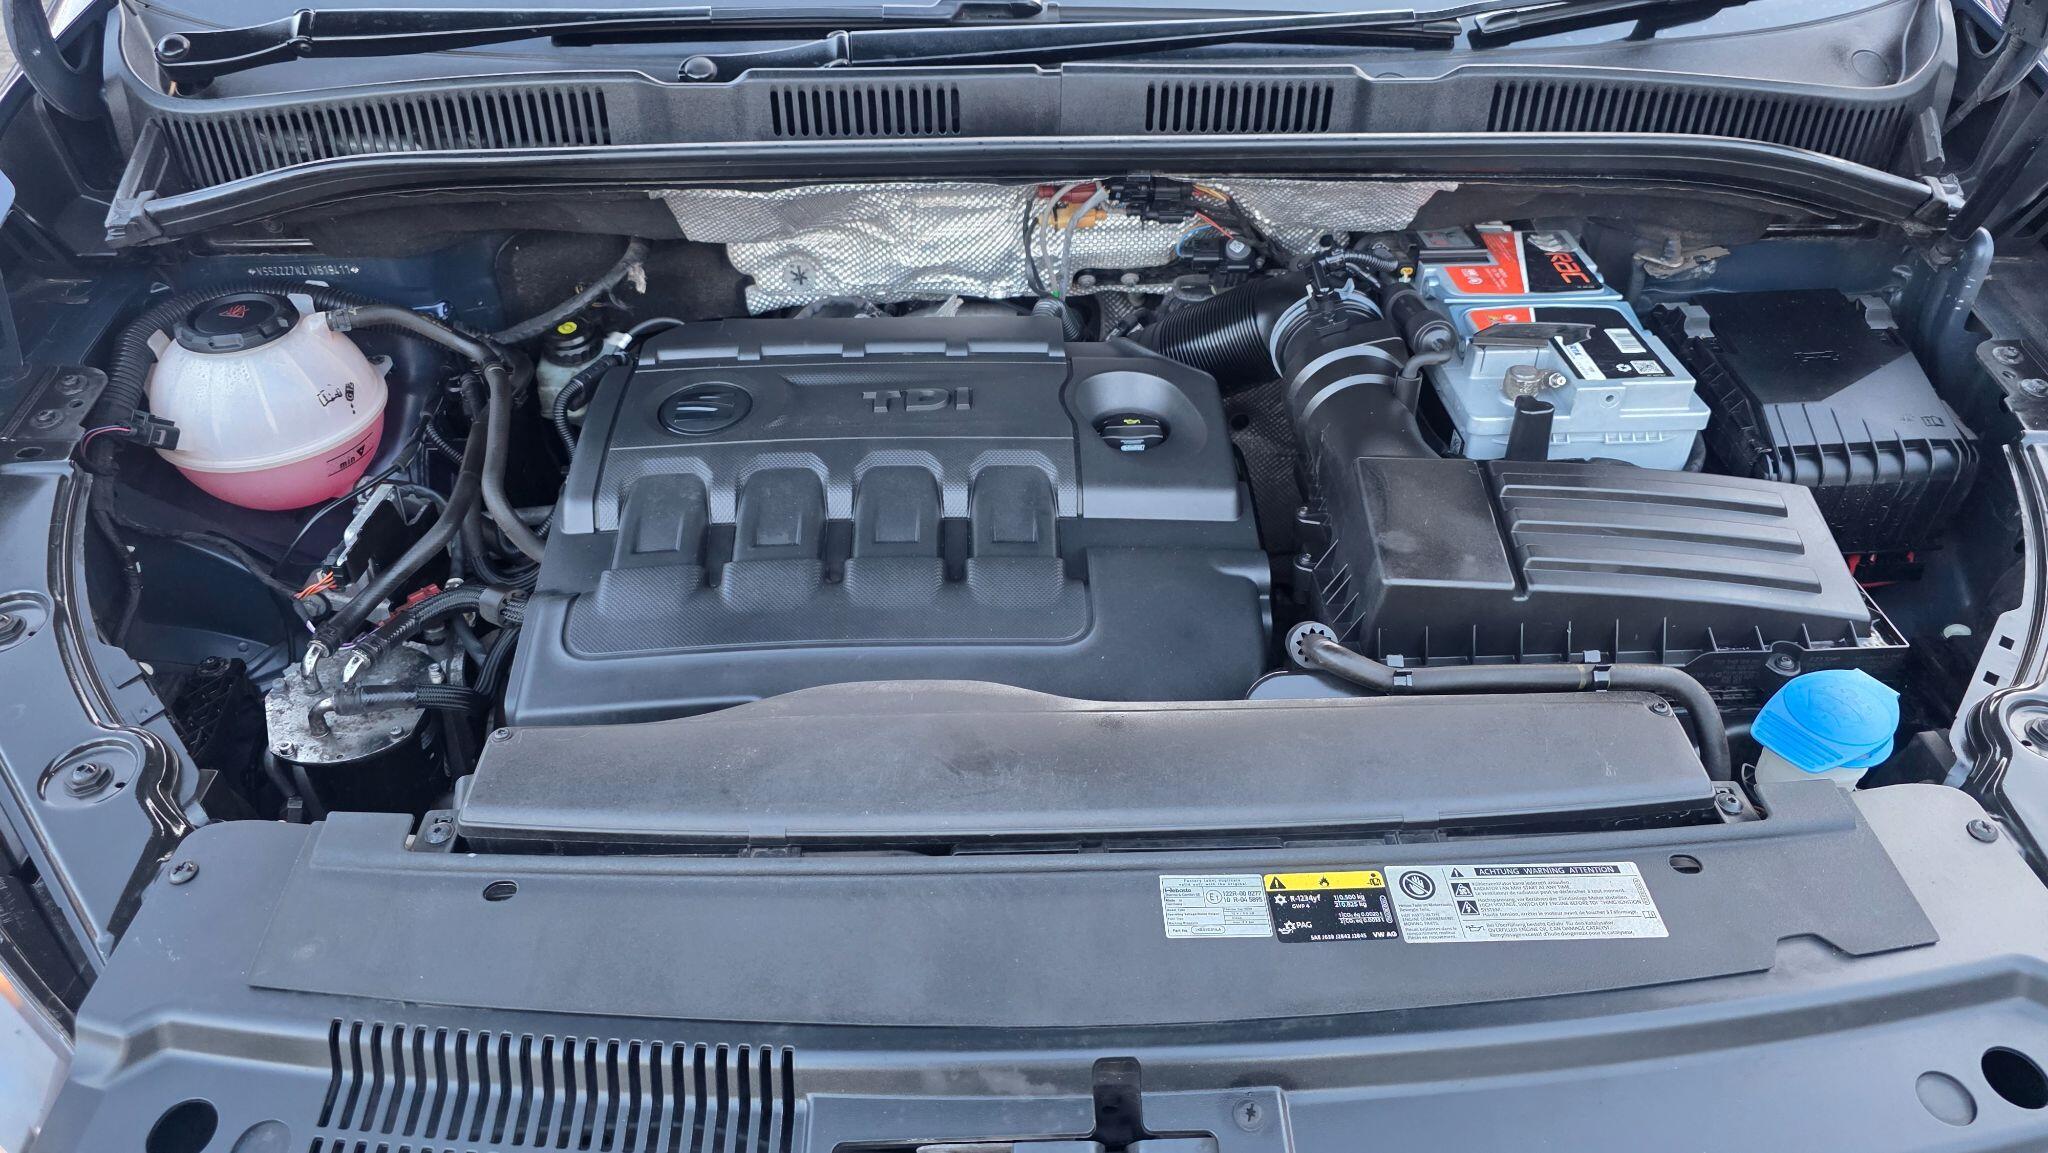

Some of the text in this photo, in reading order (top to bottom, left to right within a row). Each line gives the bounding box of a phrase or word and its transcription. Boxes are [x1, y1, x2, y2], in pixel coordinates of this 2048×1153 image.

[863, 387, 972, 413] TDI
[340, 456, 355, 469] min
[1569, 865, 1615, 873] ATTENTION
[1296, 921, 1312, 929] PAG
